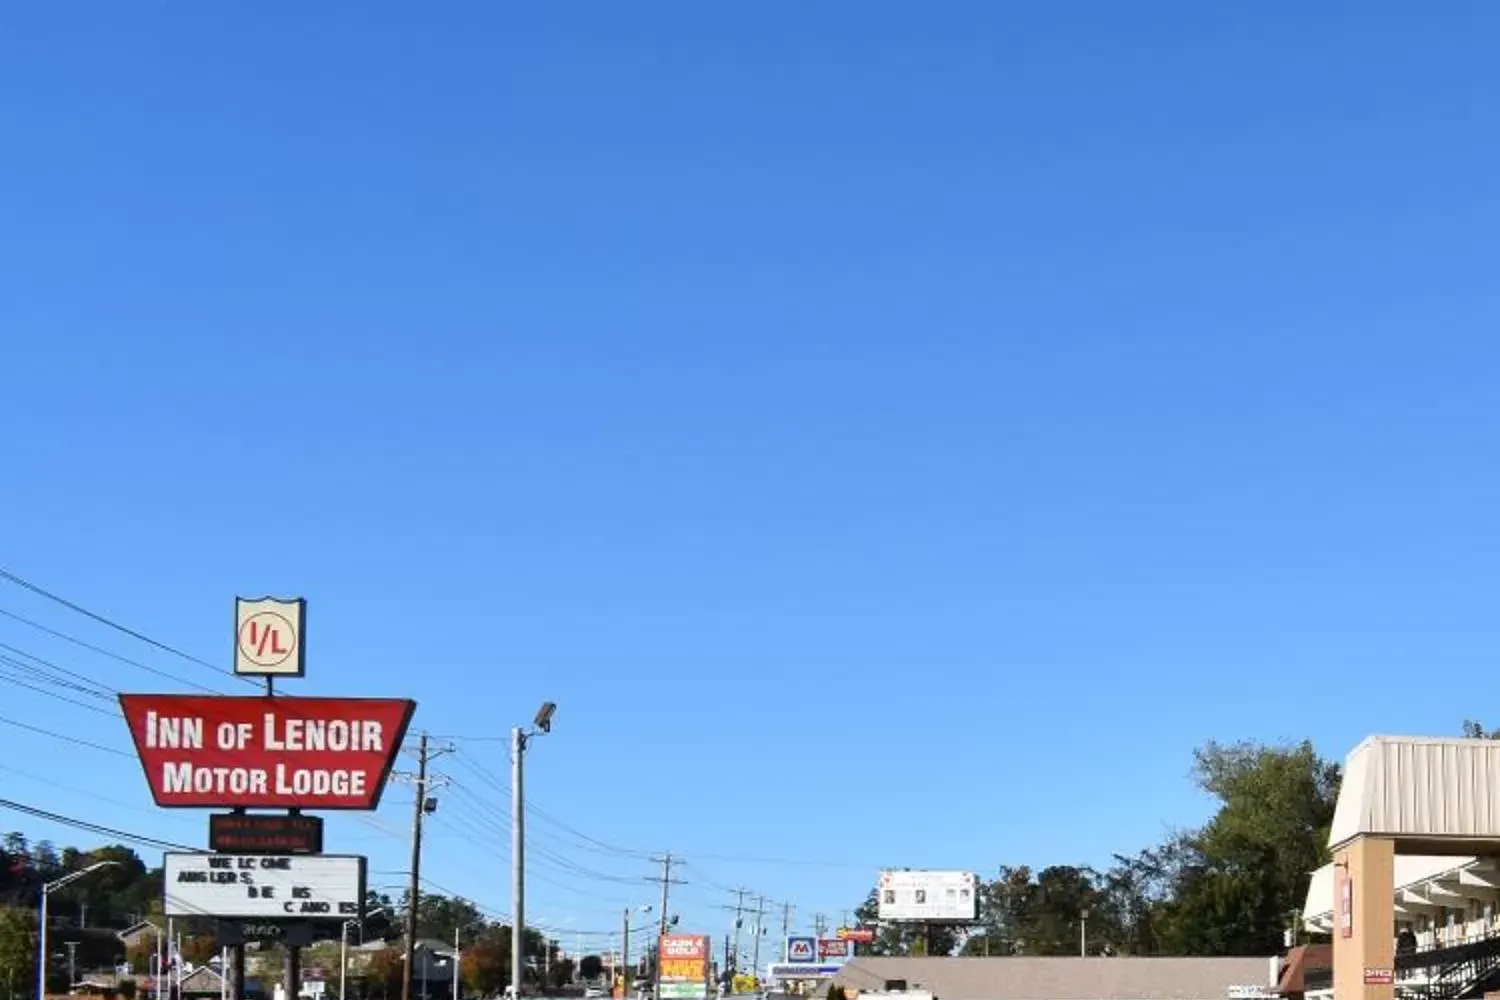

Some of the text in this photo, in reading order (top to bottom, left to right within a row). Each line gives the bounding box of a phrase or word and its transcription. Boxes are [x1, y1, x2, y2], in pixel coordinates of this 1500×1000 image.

[146, 712, 383, 751] INN OF LENOIR
[162, 762, 366, 796] MOTOR LODGE
